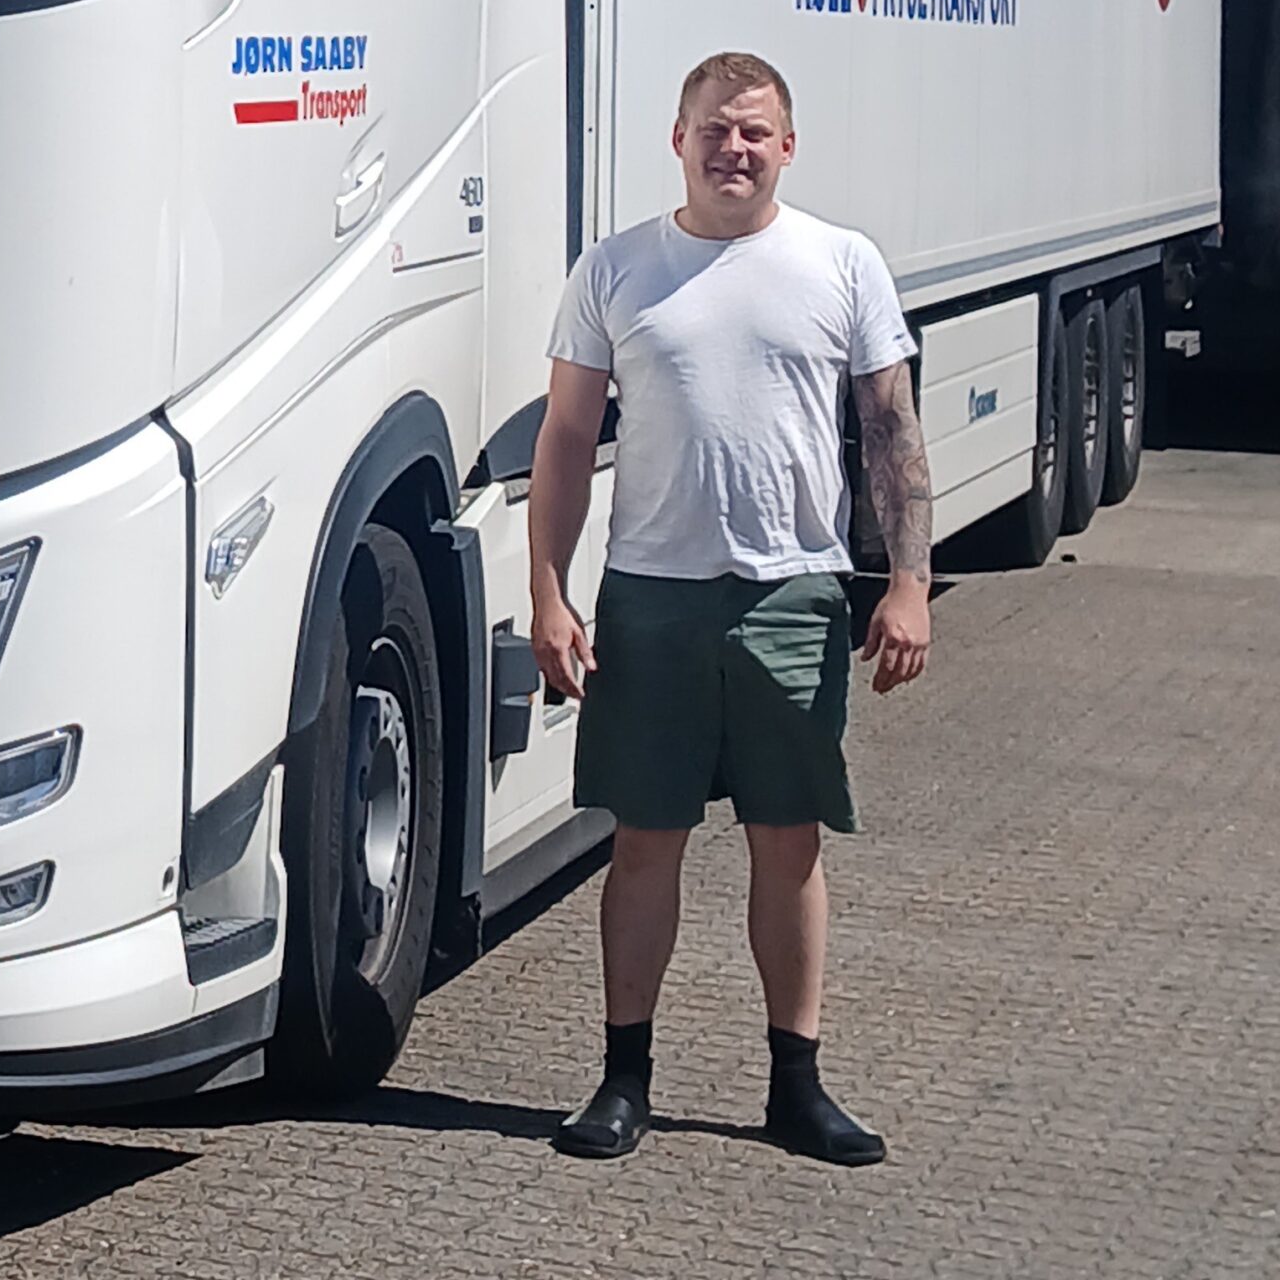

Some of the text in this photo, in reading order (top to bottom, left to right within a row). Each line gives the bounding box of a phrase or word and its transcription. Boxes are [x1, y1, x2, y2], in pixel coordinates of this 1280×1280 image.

[231, 35, 368, 75] JØRN SAABY
[302, 80, 368, 126] Transport
